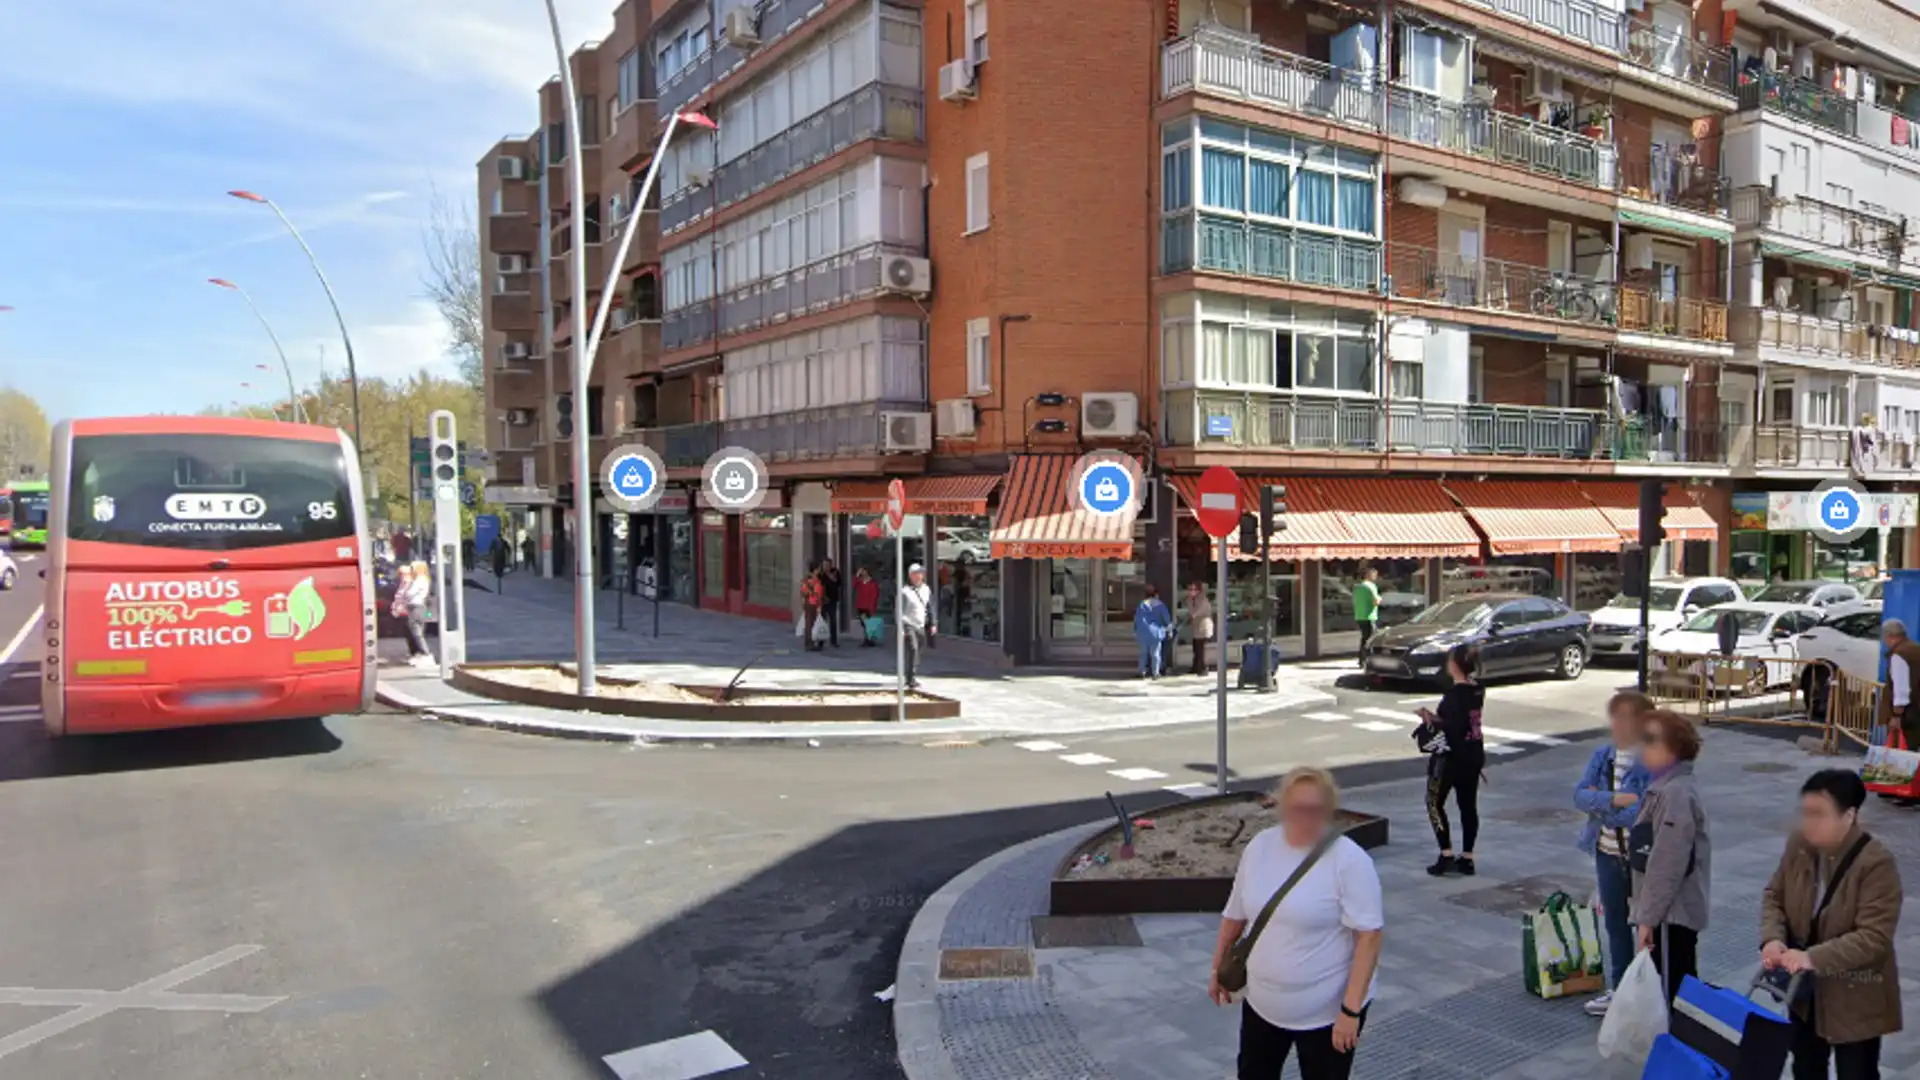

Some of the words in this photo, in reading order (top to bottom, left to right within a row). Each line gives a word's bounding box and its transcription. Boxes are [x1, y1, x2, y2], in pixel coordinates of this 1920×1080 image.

[307, 501, 337, 520] 95
[149, 522, 201, 532] CONECTA
[105, 577, 240, 601] AUTOBÚS
[107, 607, 178, 626] 100%
[108, 625, 252, 650] ELÉCTRICO
